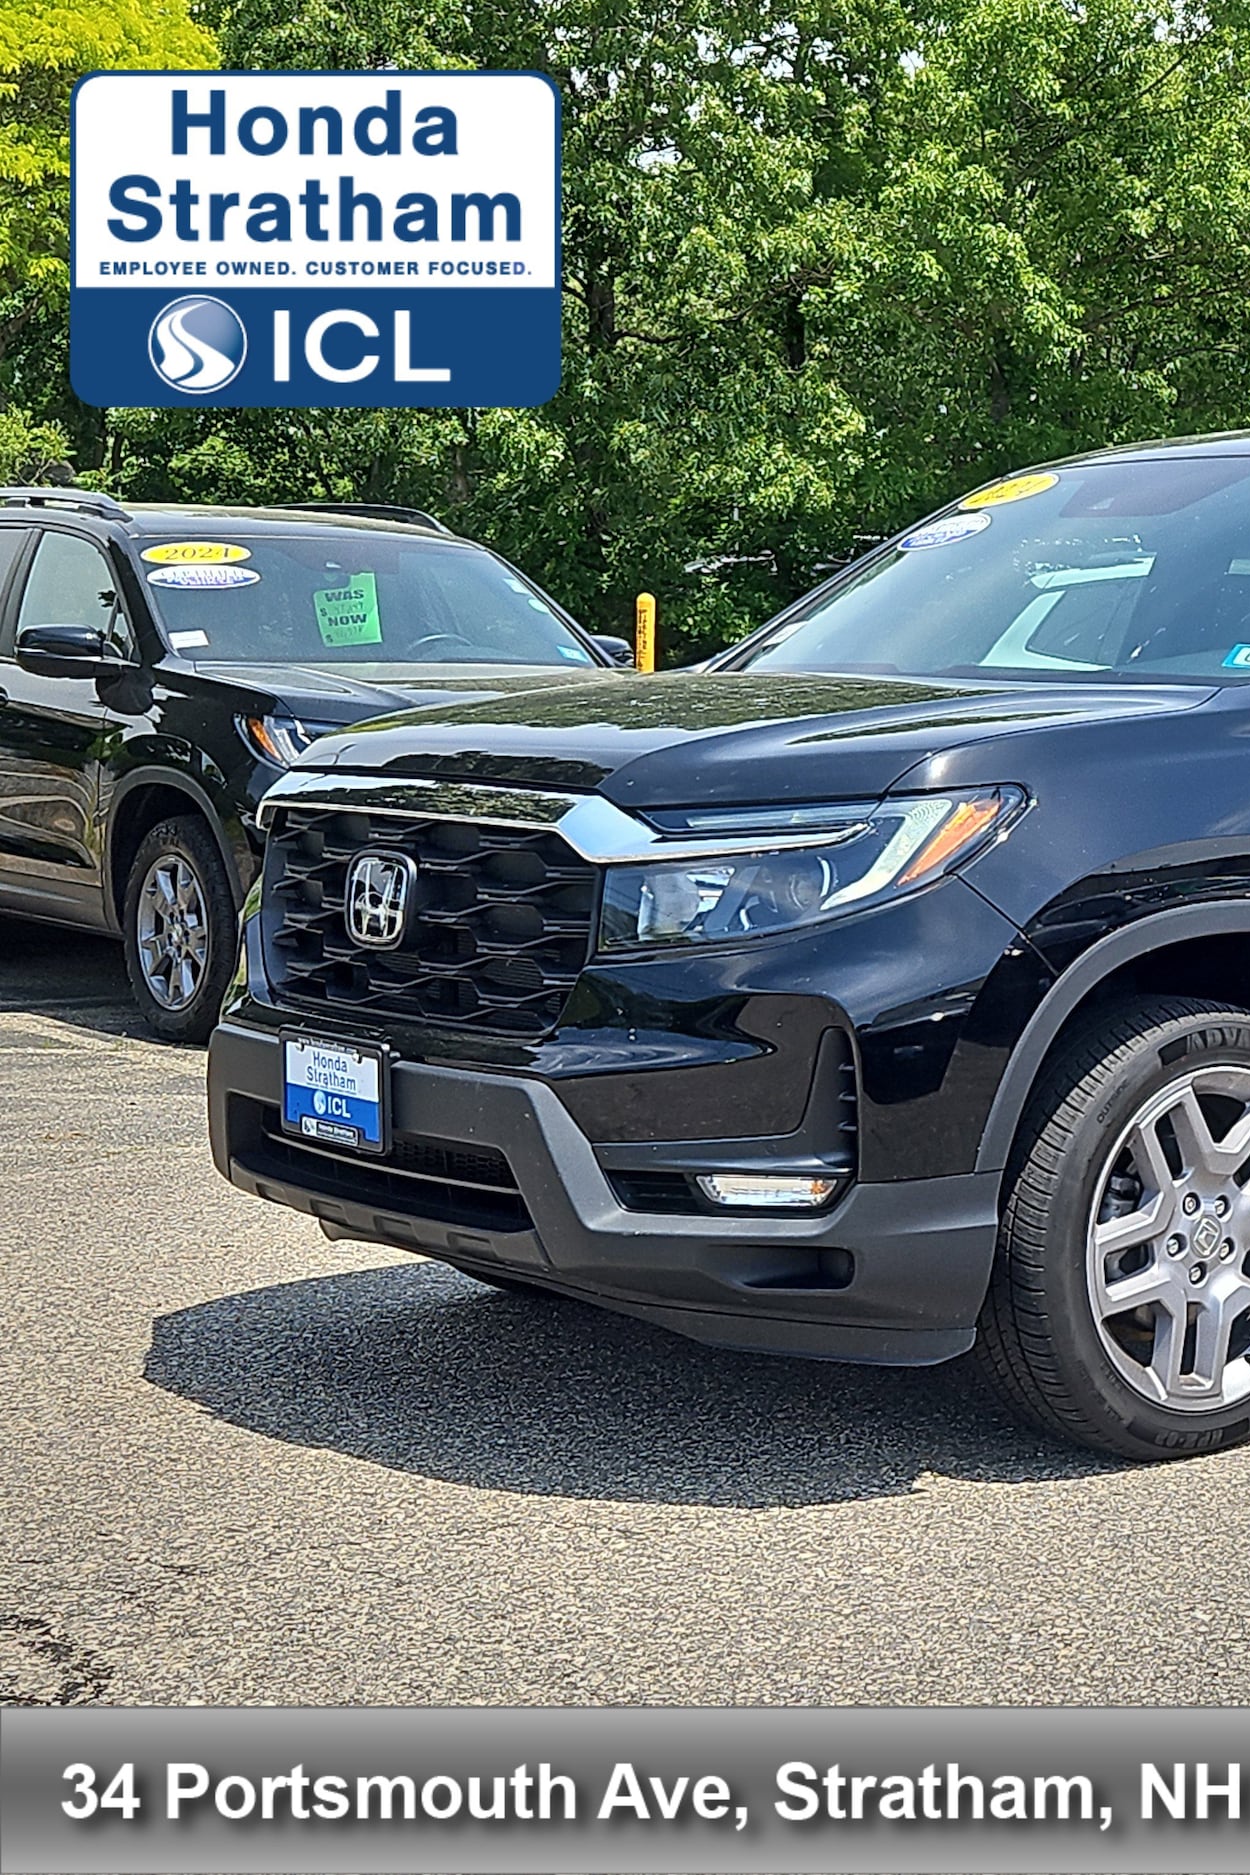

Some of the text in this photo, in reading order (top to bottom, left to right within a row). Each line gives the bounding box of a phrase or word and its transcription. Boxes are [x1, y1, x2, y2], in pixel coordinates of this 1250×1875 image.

[325, 589, 364, 602] WAS
[328, 614, 367, 627] NOW
[312, 1051, 348, 1073] Honda
[306, 1065, 356, 1091] Stratham
[327, 1096, 351, 1118] ICL
